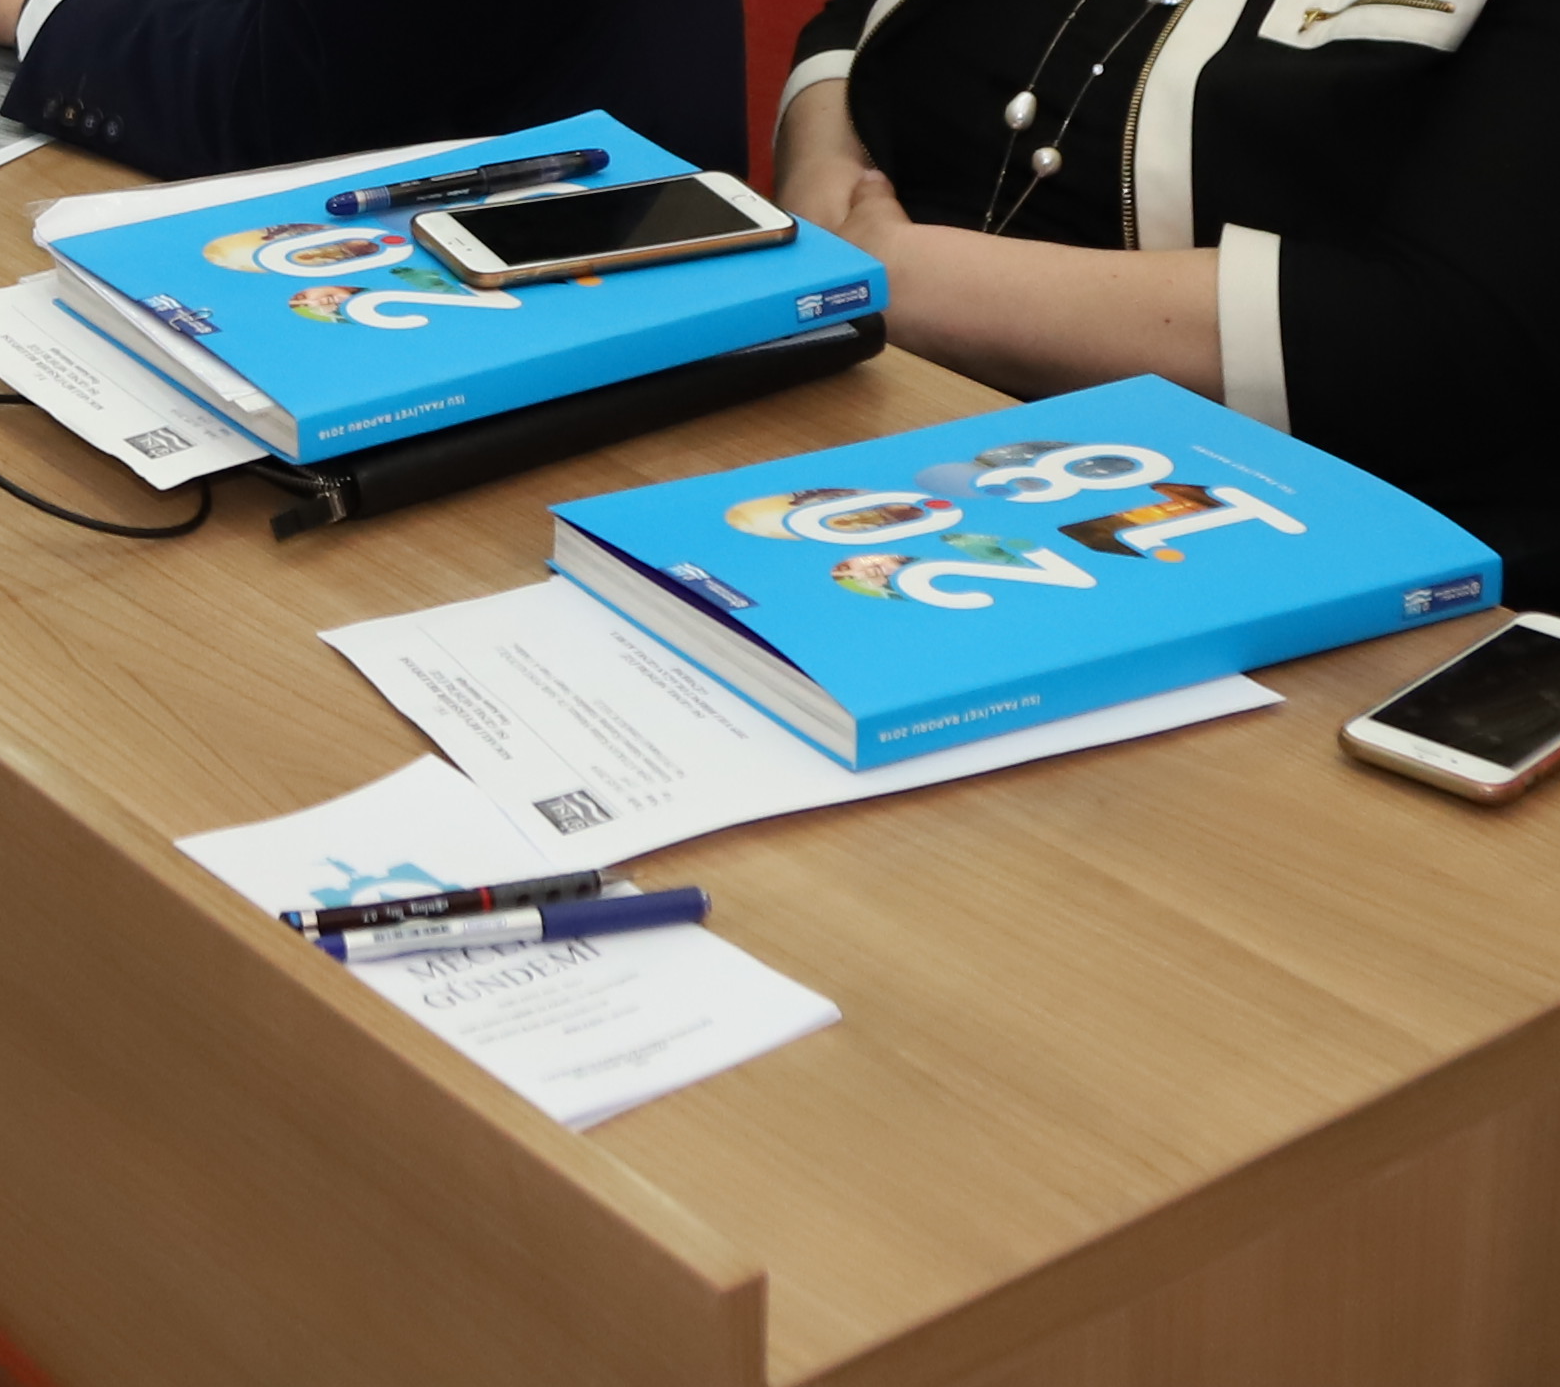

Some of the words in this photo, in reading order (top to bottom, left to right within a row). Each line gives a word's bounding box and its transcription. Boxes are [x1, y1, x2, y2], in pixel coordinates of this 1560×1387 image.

[447, 394, 466, 408] İSU
[395, 399, 445, 422] FAALİYET
[348, 413, 392, 433] RAPORU
[318, 426, 345, 441] 2018
[1021, 694, 1041, 708] İSU
[964, 702, 1018, 723] FAALİYET
[912, 713, 961, 735] RAPORU
[879, 726, 908, 743] 2018
